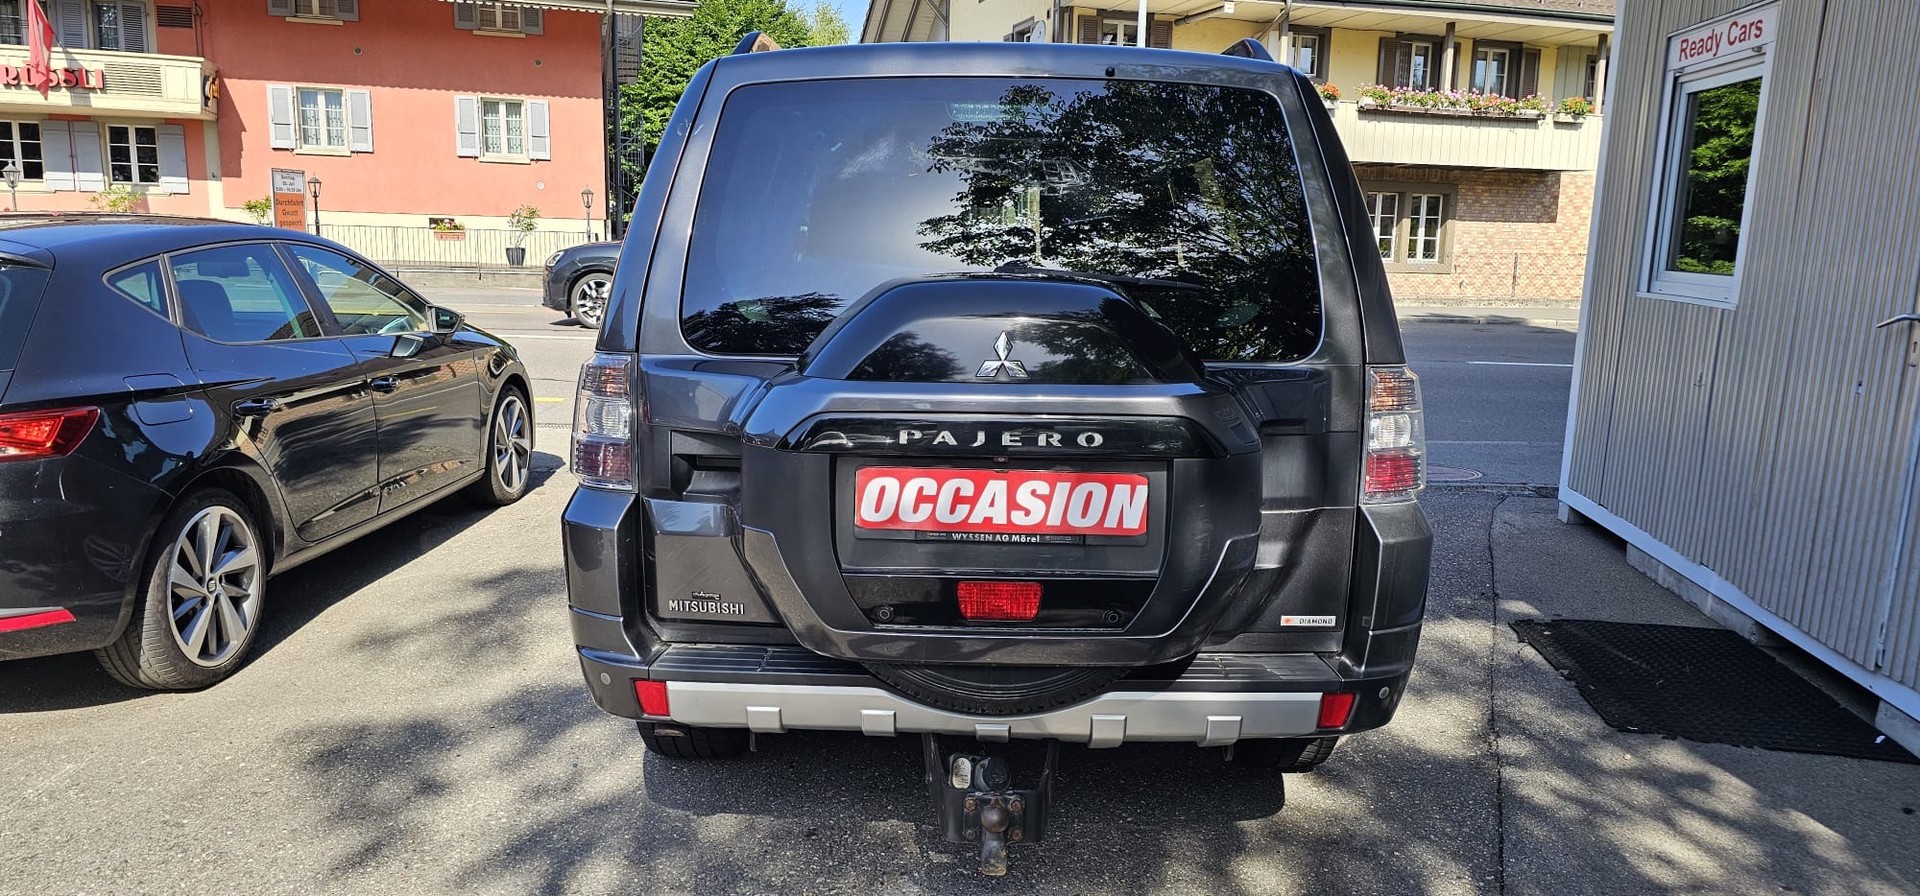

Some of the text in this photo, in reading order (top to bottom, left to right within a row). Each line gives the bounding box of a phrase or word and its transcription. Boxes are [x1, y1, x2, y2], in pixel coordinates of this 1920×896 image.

[1678, 19, 1764, 62] Ready Cars
[898, 429, 1104, 448] PAJERO
[859, 476, 1148, 529] OCCASION
[952, 532, 993, 542] WYSSEN
[995, 534, 1010, 543] AG
[1011, 534, 1040, 543] Mörel
[668, 599, 744, 615] MITSUBISHI
